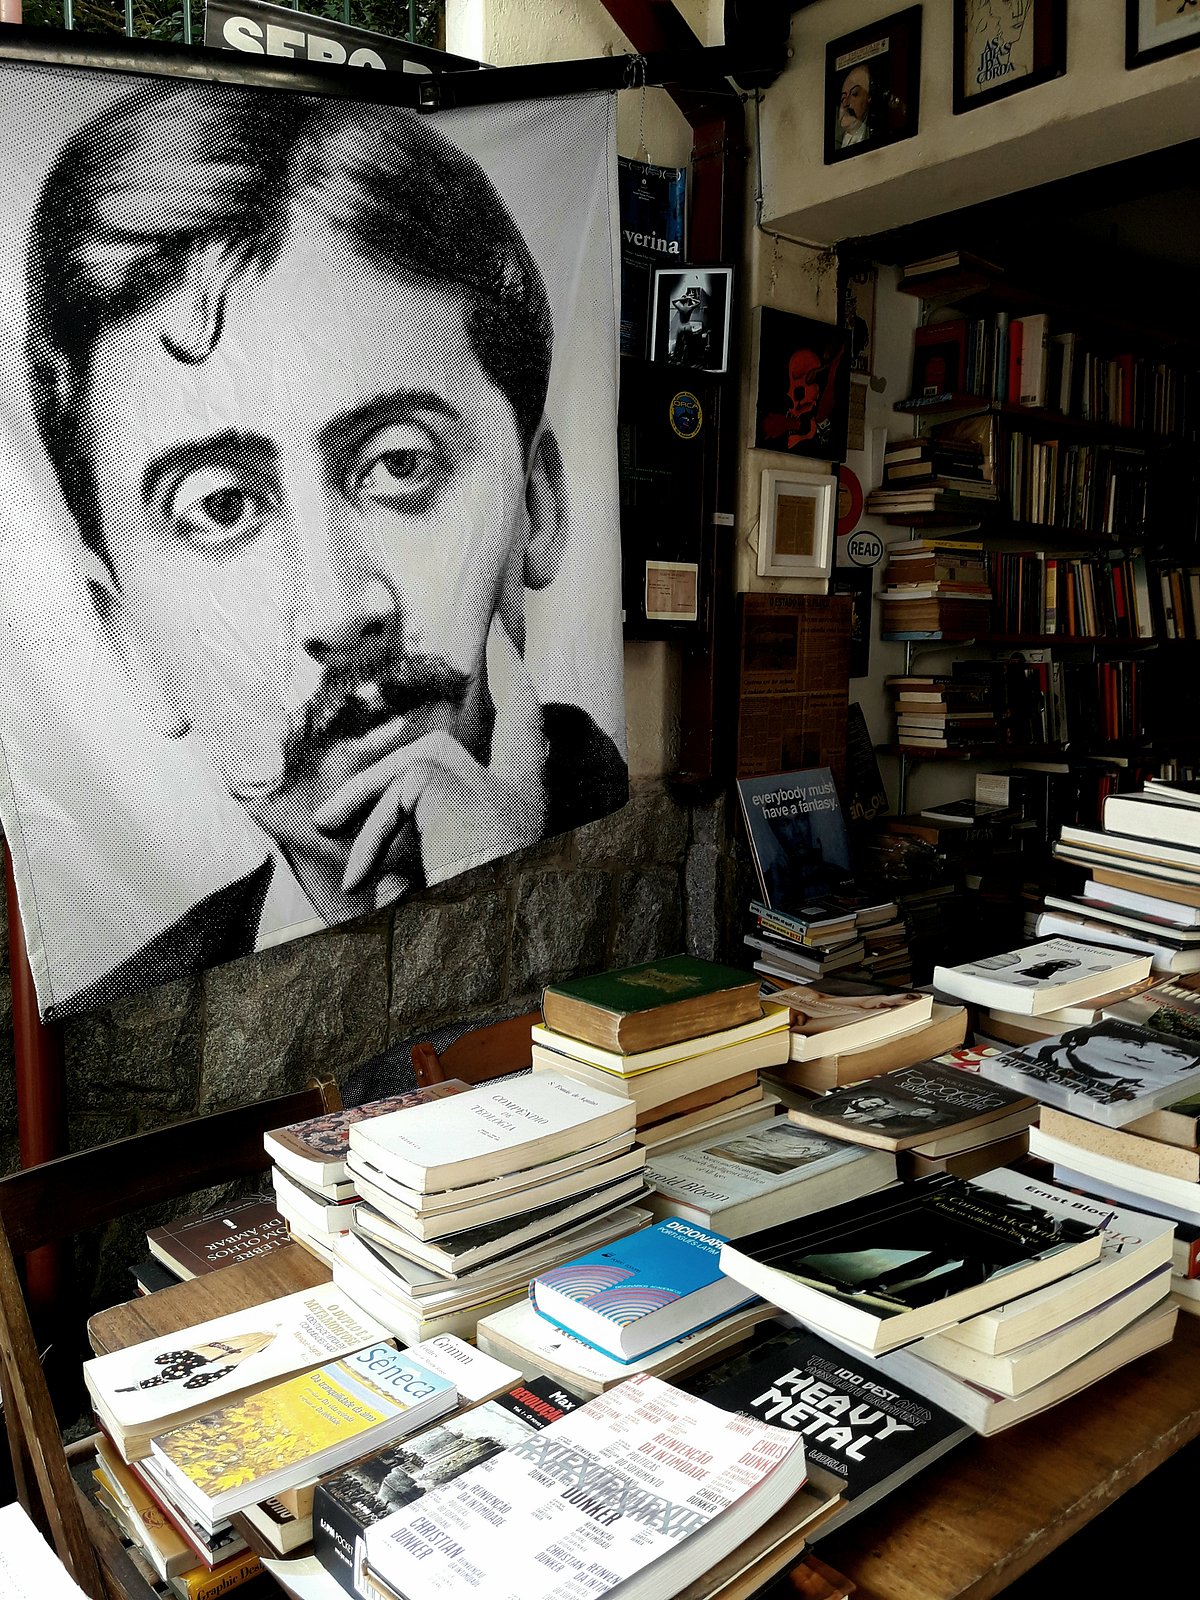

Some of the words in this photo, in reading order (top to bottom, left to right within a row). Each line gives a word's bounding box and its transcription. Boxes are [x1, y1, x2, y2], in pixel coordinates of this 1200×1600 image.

[623, 229, 680, 255] verina
[673, 399, 699, 410] ORCA
[851, 541, 880, 557] READ
[752, 785, 807, 806] everybody
[808, 781, 835, 797] must
[762, 806, 788, 820] have
[790, 806, 798, 814] a
[799, 798, 839, 813] fantasy.
[893, 1068, 1006, 1107] Fotografia
[470, 1104, 516, 1132] TEOLOGIA
[641, 1166, 683, 1189] arold
[680, 1181, 730, 1203] Bloom
[1024, 1184, 1068, 1205] Ernst
[936, 1202, 957, 1214] Onde
[949, 1196, 997, 1219] Cormac
[996, 1214, 1066, 1243] McCarthy
[259, 1218, 283, 1231] DE
[262, 1226, 287, 1240] OM
[207, 1237, 261, 1262] OLHOS
[233, 1240, 281, 1262] LEBRE
[304, 1299, 361, 1346] METAMORFOSE
[332, 1310, 362, 1331] DUPLO
[433, 1337, 474, 1365] Grimm
[356, 1347, 436, 1399] Sêneca
[310, 1374, 321, 1383] Da
[352, 1405, 362, 1413] da
[359, 1411, 377, 1422] alma
[803, 1365, 865, 1396] ABSOLUTE
[863, 1392, 927, 1428] GREATEST
[806, 1354, 838, 1371] THE
[833, 1367, 865, 1386] 100
[863, 1381, 901, 1402] BEST
[895, 1400, 932, 1422] AND
[509, 1387, 565, 1423] REVOLUÇÃ
[549, 1391, 576, 1411] Max
[643, 1402, 679, 1422] CHRISTIAN
[773, 1367, 915, 1440] HEAVY
[634, 1408, 661, 1424] DUNKER
[750, 1386, 874, 1462] METAL
[725, 1421, 754, 1437] DUNKER
[638, 1442, 656, 1454] DA
[651, 1448, 711, 1481] INTIMIDADE
[652, 1433, 714, 1465] REINVENÇÃO
[752, 1440, 788, 1459] CHRIS
[615, 1458, 627, 1467] DO
[624, 1463, 664, 1488] SOFRIMENTO
[625, 1452, 661, 1472] POLÍTICAS
[527, 1468, 556, 1489] DUNKER
[457, 1491, 469, 1503] DA
[465, 1498, 507, 1528] INTIMIDADE
[469, 1484, 512, 1515] REINVENÇÃO
[560, 1486, 623, 1527] DUNKER
[686, 1495, 718, 1514] DUNKER
[696, 1488, 731, 1508] CHRISTIA
[335, 1532, 354, 1555] POCKET
[409, 1516, 466, 1559] CHRISTIAN
[584, 1521, 615, 1541] REINVENÇÃO
[390, 1527, 433, 1561] DUNKER
[534, 1551, 565, 1573] DUNKER
[546, 1544, 586, 1571] CHRISTIAN
[197, 1574, 238, 1600] Graphic
[240, 1562, 266, 1582] Desi
[573, 1571, 590, 1583] DA
